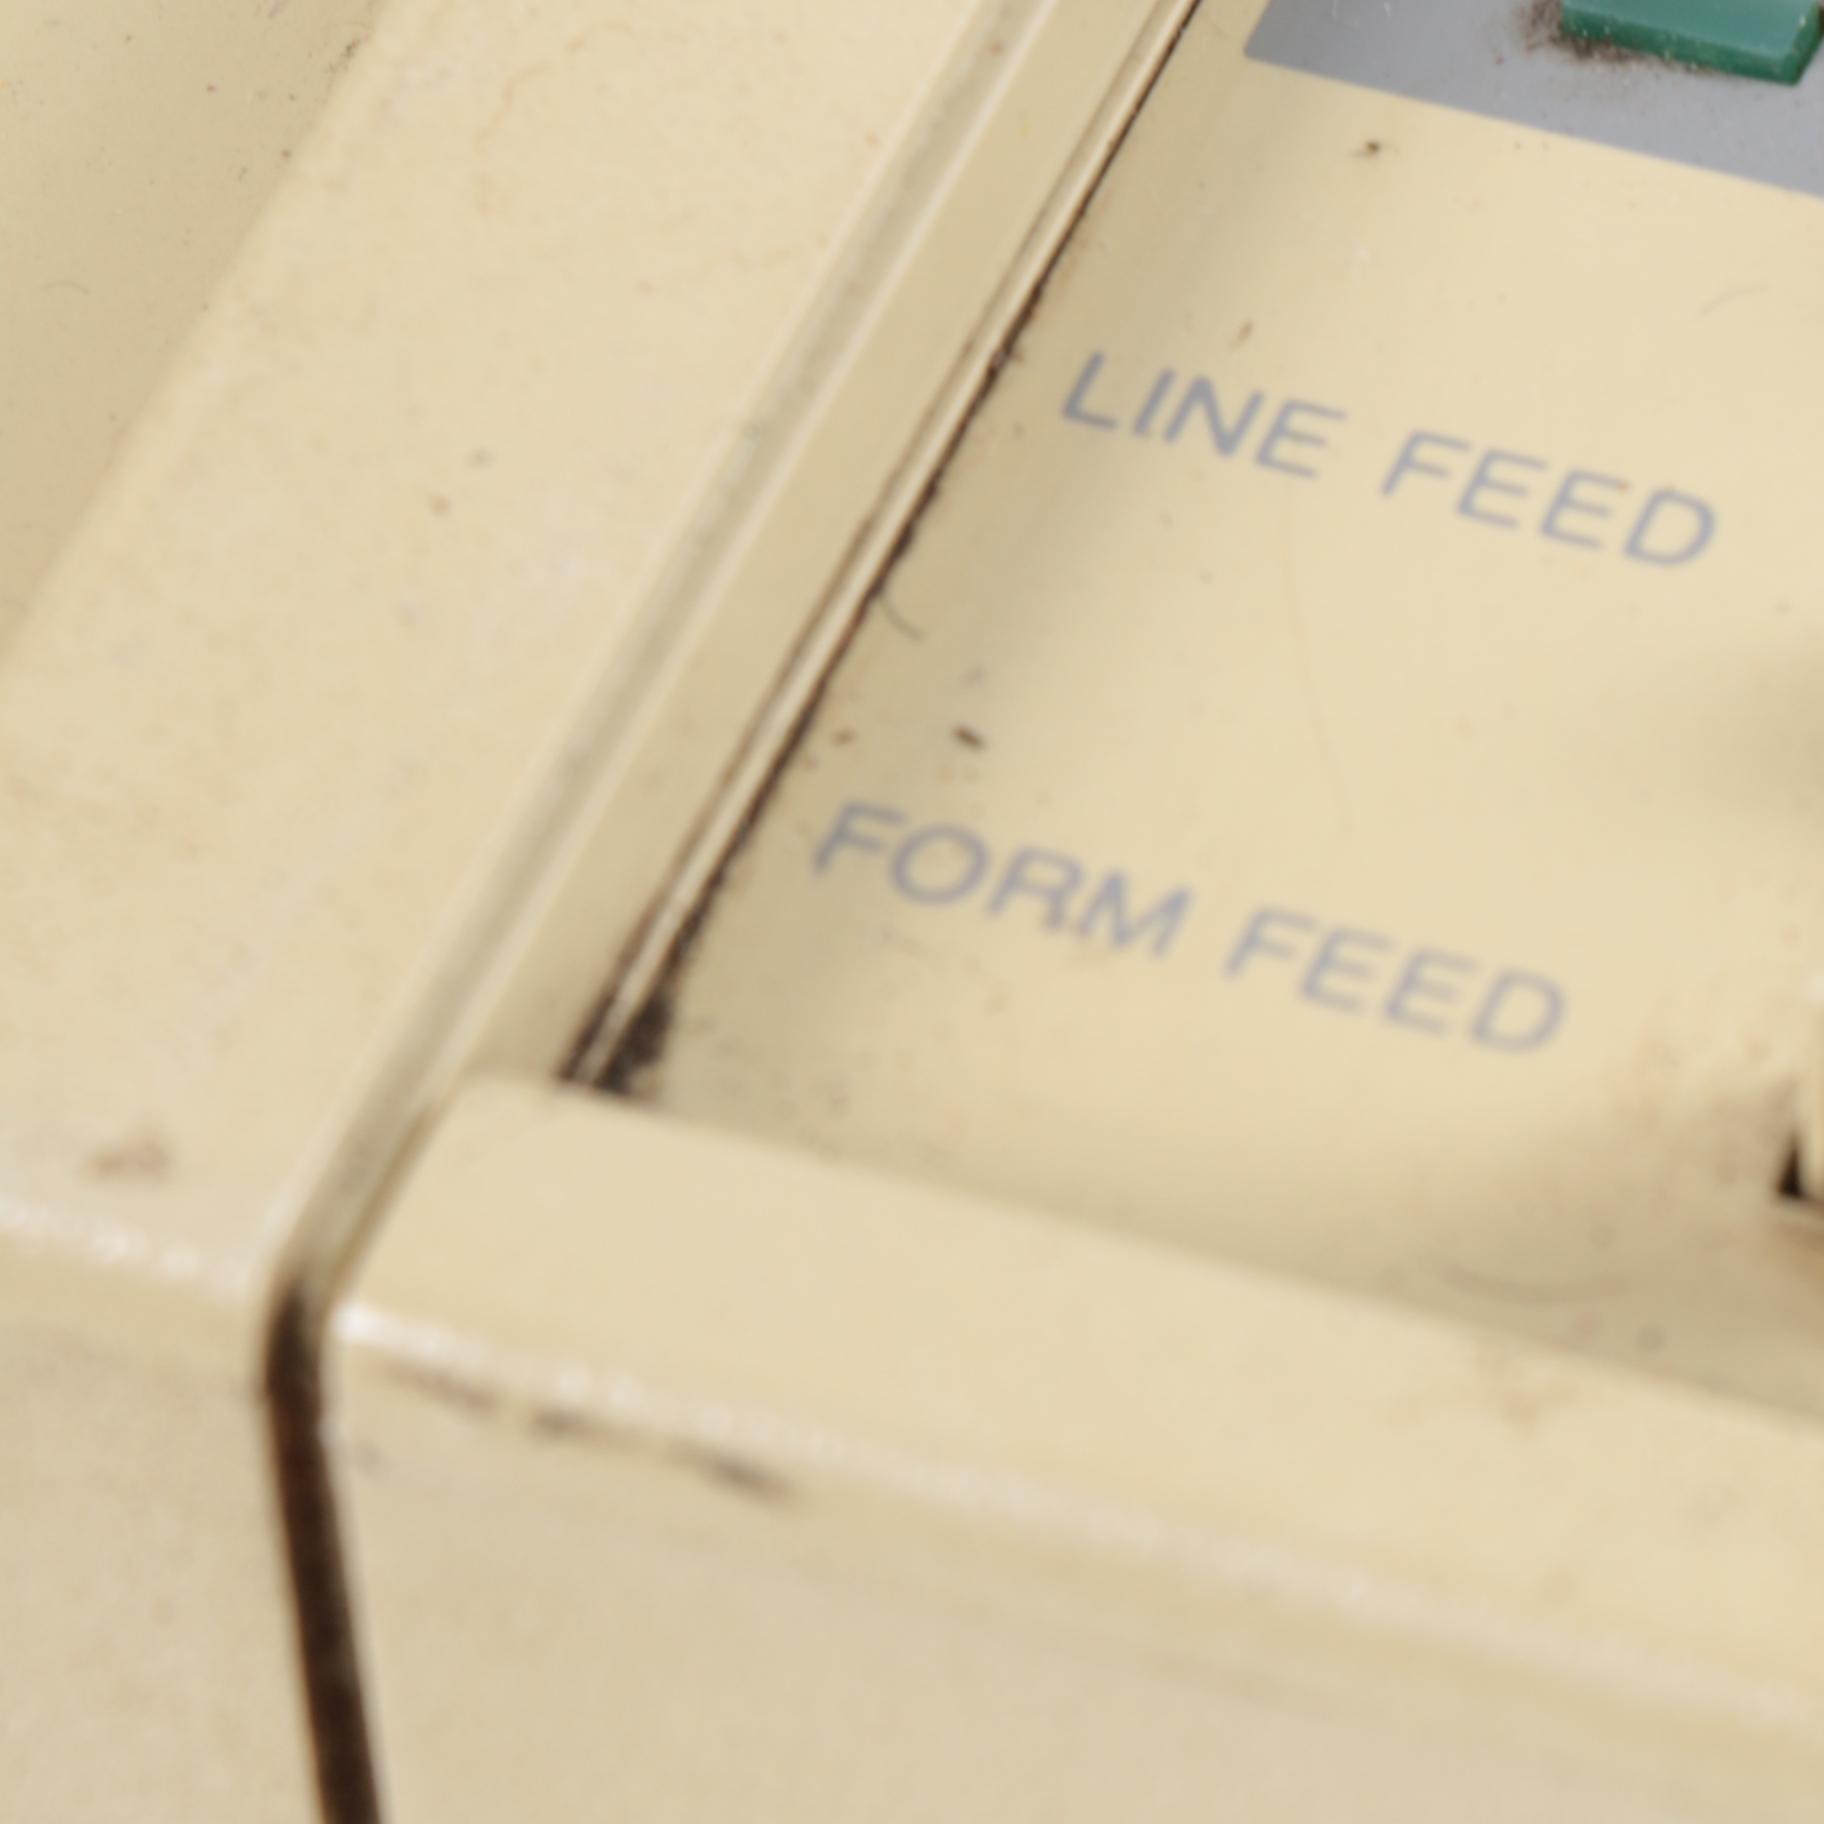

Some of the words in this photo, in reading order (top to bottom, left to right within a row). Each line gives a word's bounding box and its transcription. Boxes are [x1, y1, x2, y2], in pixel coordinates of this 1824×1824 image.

[1062, 352, 1345, 478] LINE
[1381, 430, 1717, 568] FEED
[812, 802, 1192, 957] FORM
[1224, 908, 1565, 1054] FEED
